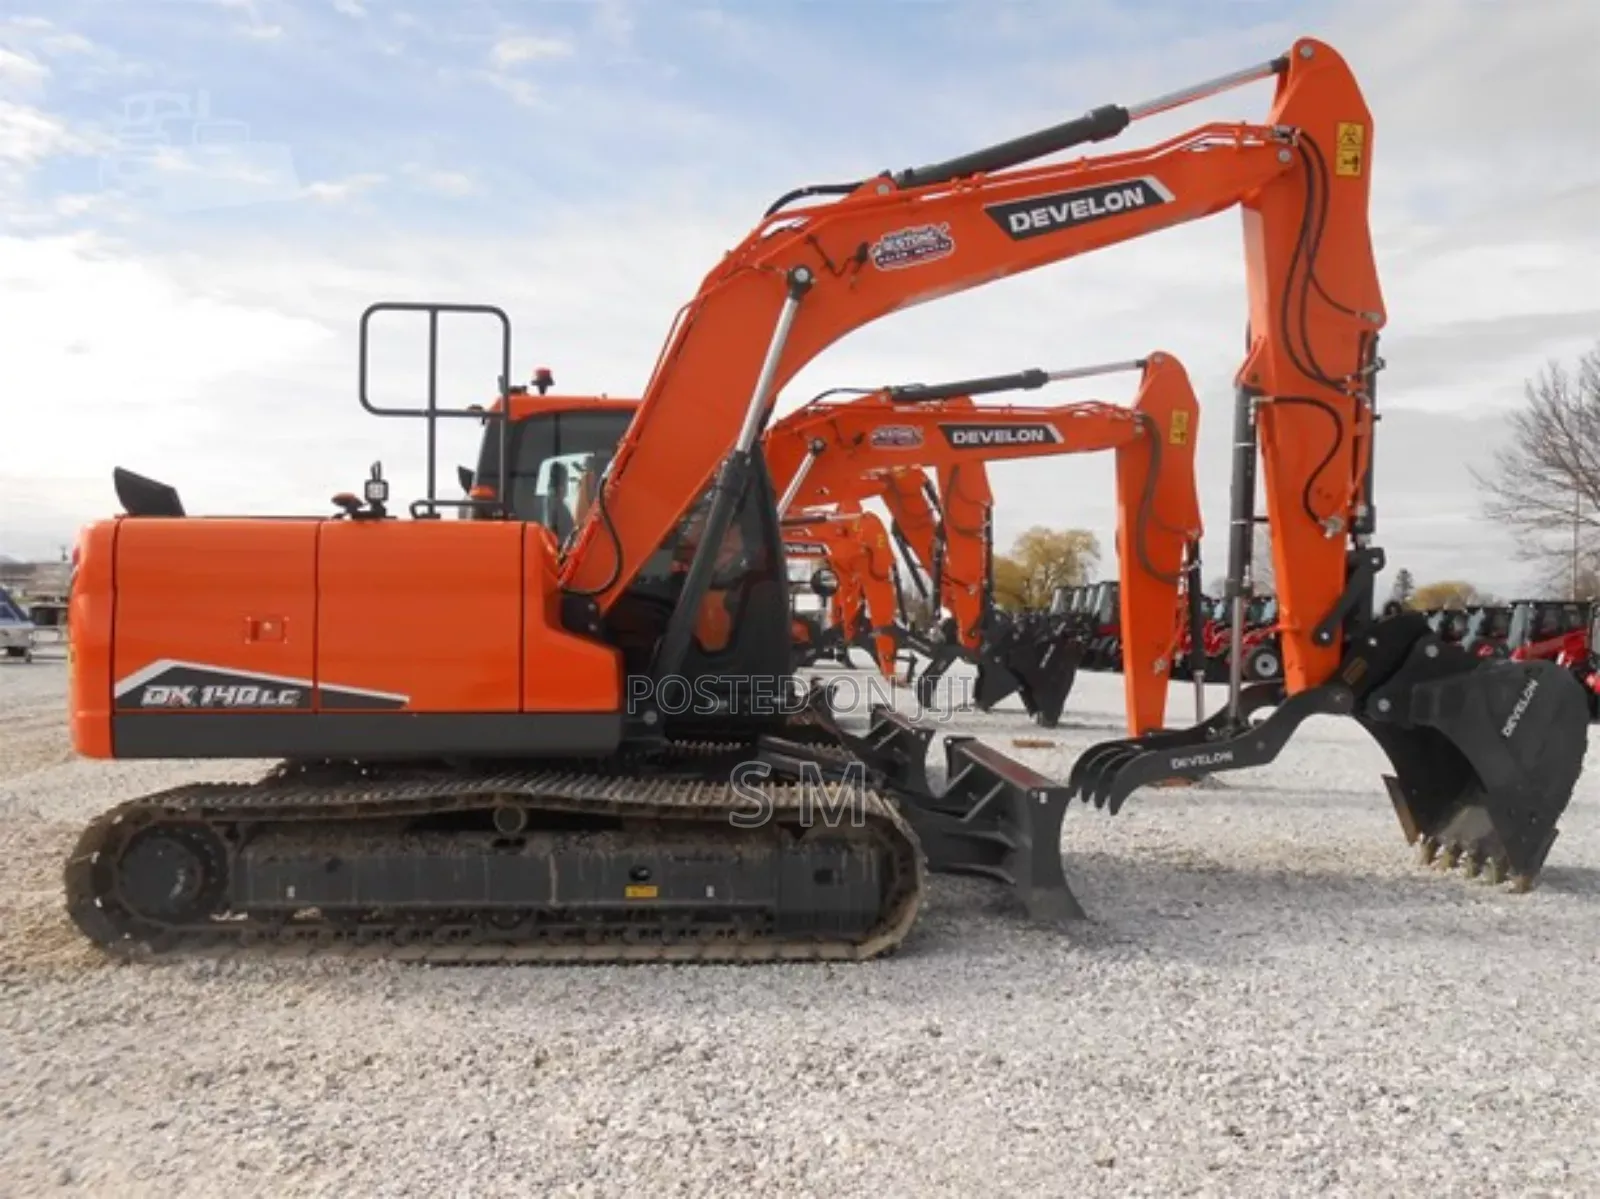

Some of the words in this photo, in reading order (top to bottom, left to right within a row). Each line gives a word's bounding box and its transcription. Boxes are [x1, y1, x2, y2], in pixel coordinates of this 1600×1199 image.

[1008, 187, 1145, 233] DEVELON
[952, 429, 1044, 444] DEVELON
[141, 685, 197, 706] DX
[1502, 679, 1540, 738] DEVELON
[1170, 750, 1234, 770] DEVELON
